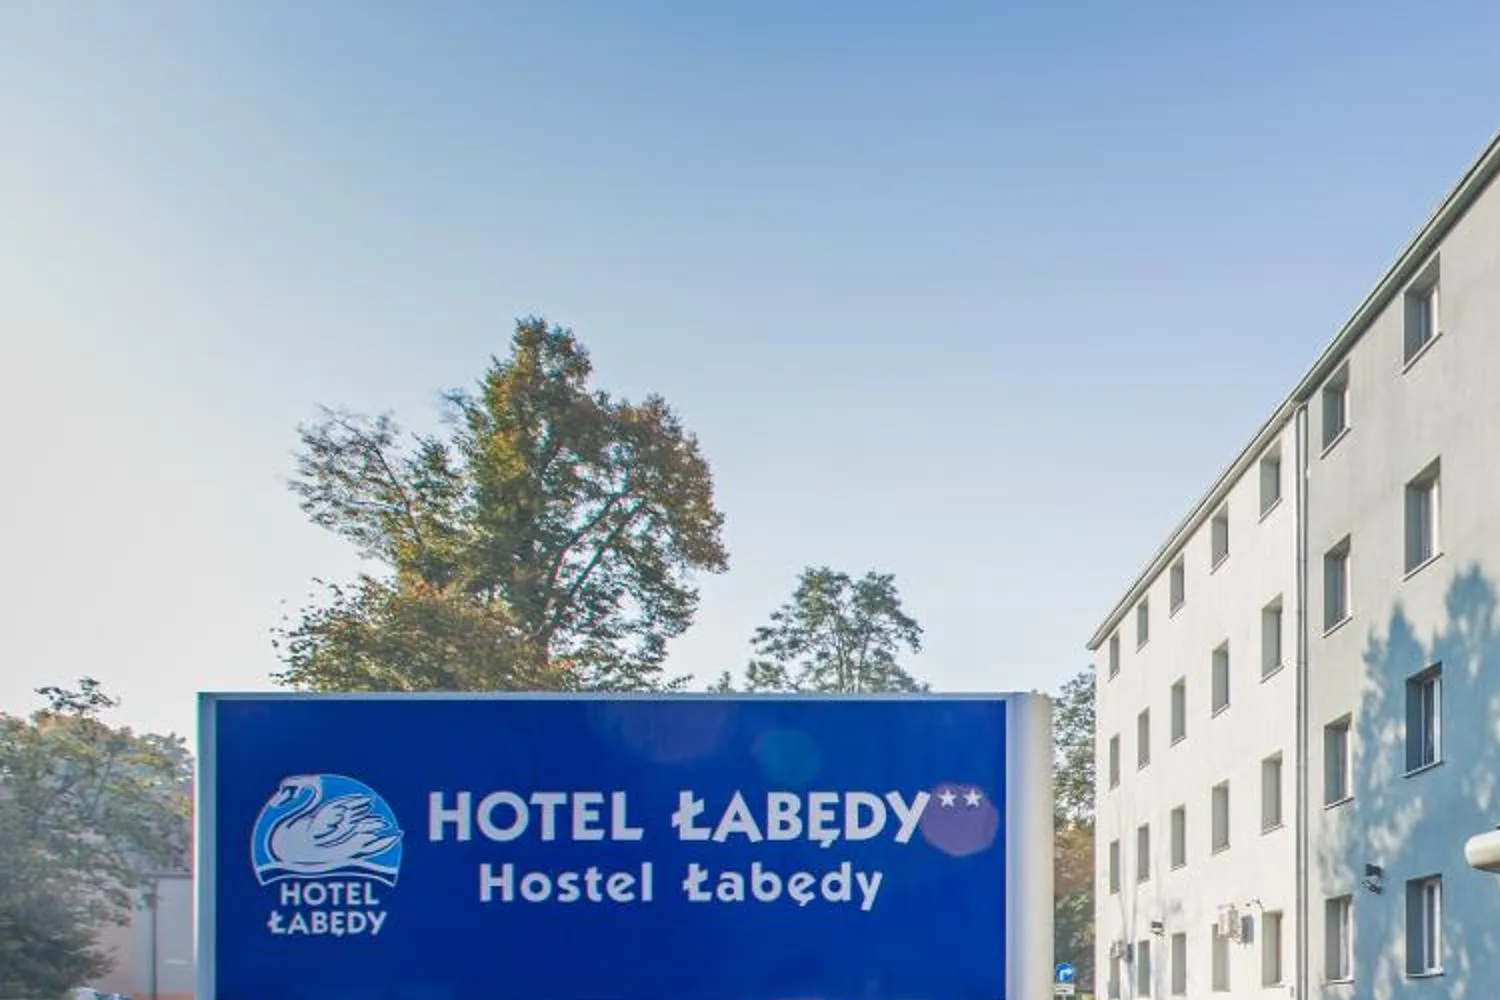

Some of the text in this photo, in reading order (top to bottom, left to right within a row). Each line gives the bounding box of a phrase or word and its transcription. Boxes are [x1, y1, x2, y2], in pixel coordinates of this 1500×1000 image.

[429, 791, 932, 848] HOTEL ŁABĘDY
[280, 883, 379, 905] HOTEL
[480, 862, 884, 911] Hostel Łabędy
[267, 911, 387, 936] ŁABĘDY
